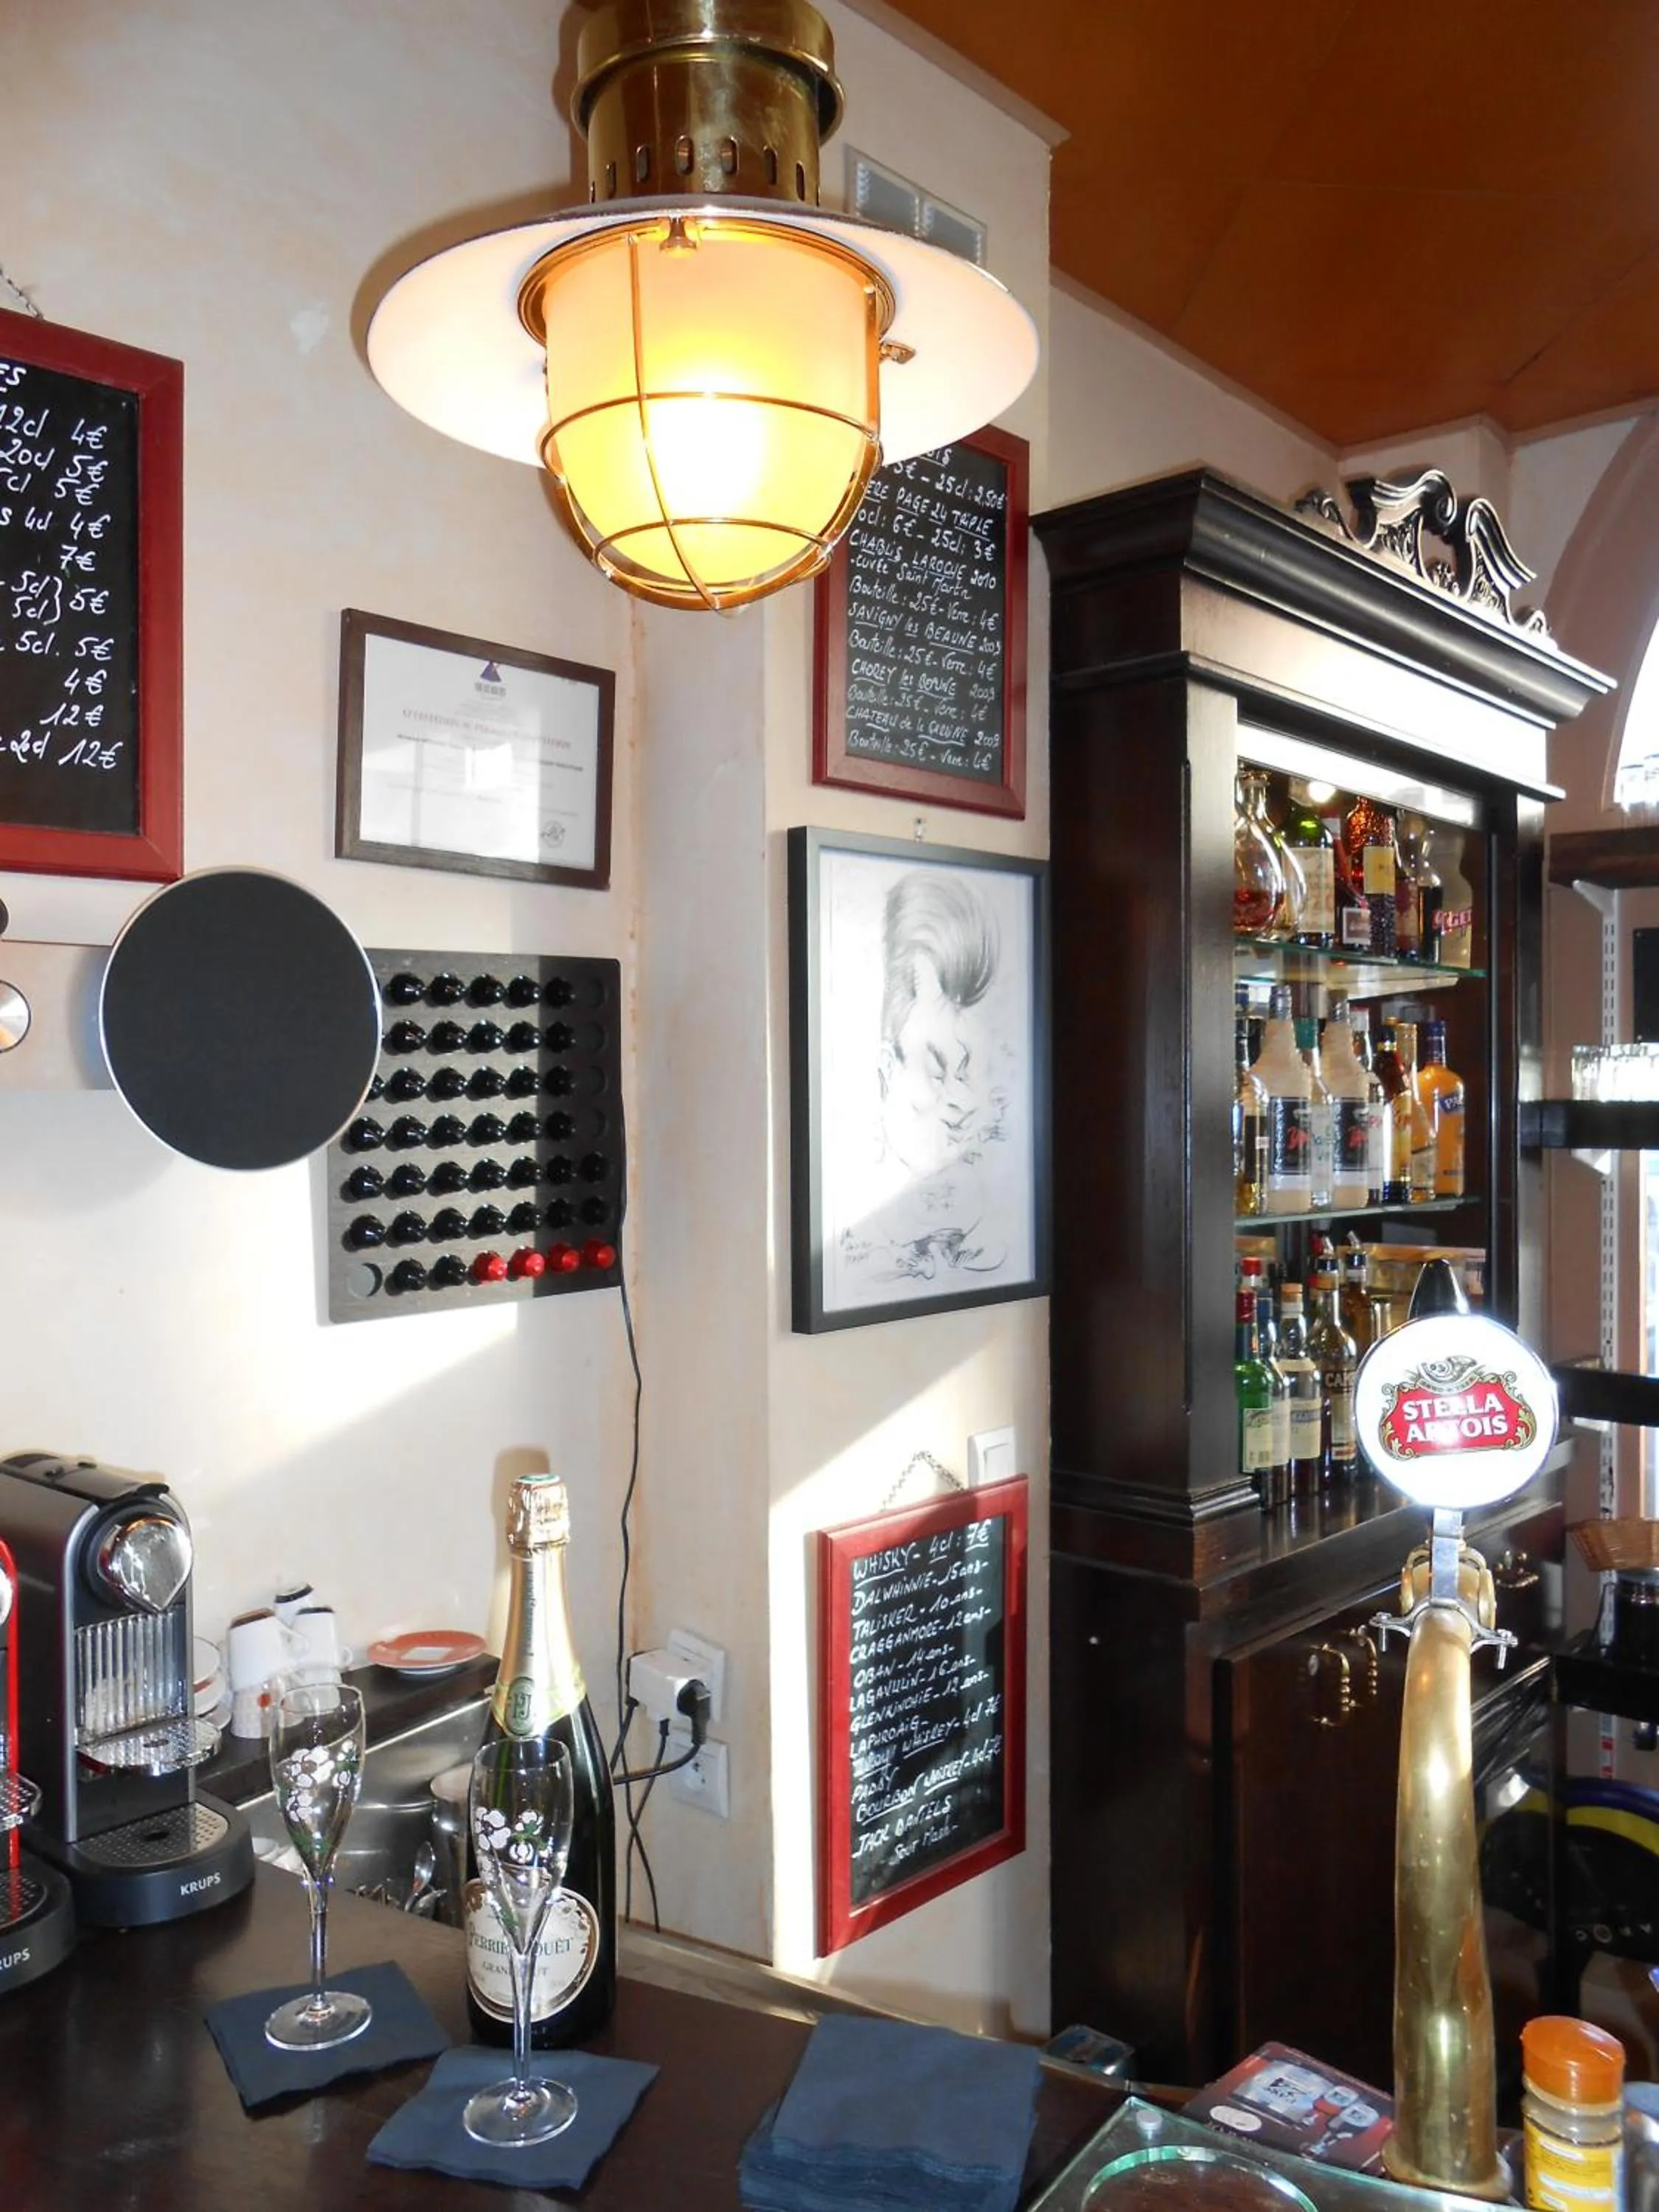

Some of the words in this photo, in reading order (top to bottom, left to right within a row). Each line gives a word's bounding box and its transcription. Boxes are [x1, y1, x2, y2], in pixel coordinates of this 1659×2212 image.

[72, 419, 108, 449] 4€
[66, 455, 108, 482] 5€
[55, 478, 100, 505] 5€
[897, 487, 929, 513] PAGE
[70, 512, 111, 540] 4€
[893, 514, 917, 537] 6€
[974, 540, 995, 561] 3€
[60, 544, 97, 571] 7€
[69, 588, 109, 613] 5€
[74, 636, 114, 661] 5€
[925, 622, 978, 649] BEAUNE
[58, 739, 123, 769] 12€
[1402, 1393, 1503, 1423] STELLA
[967, 1518, 992, 1546] 7€
[853, 1658, 896, 1688] OBAN
[852, 1823, 890, 1859] JACK
[180, 1872, 221, 1896] KRUPS
[0, 1948, 30, 1971] UPS
